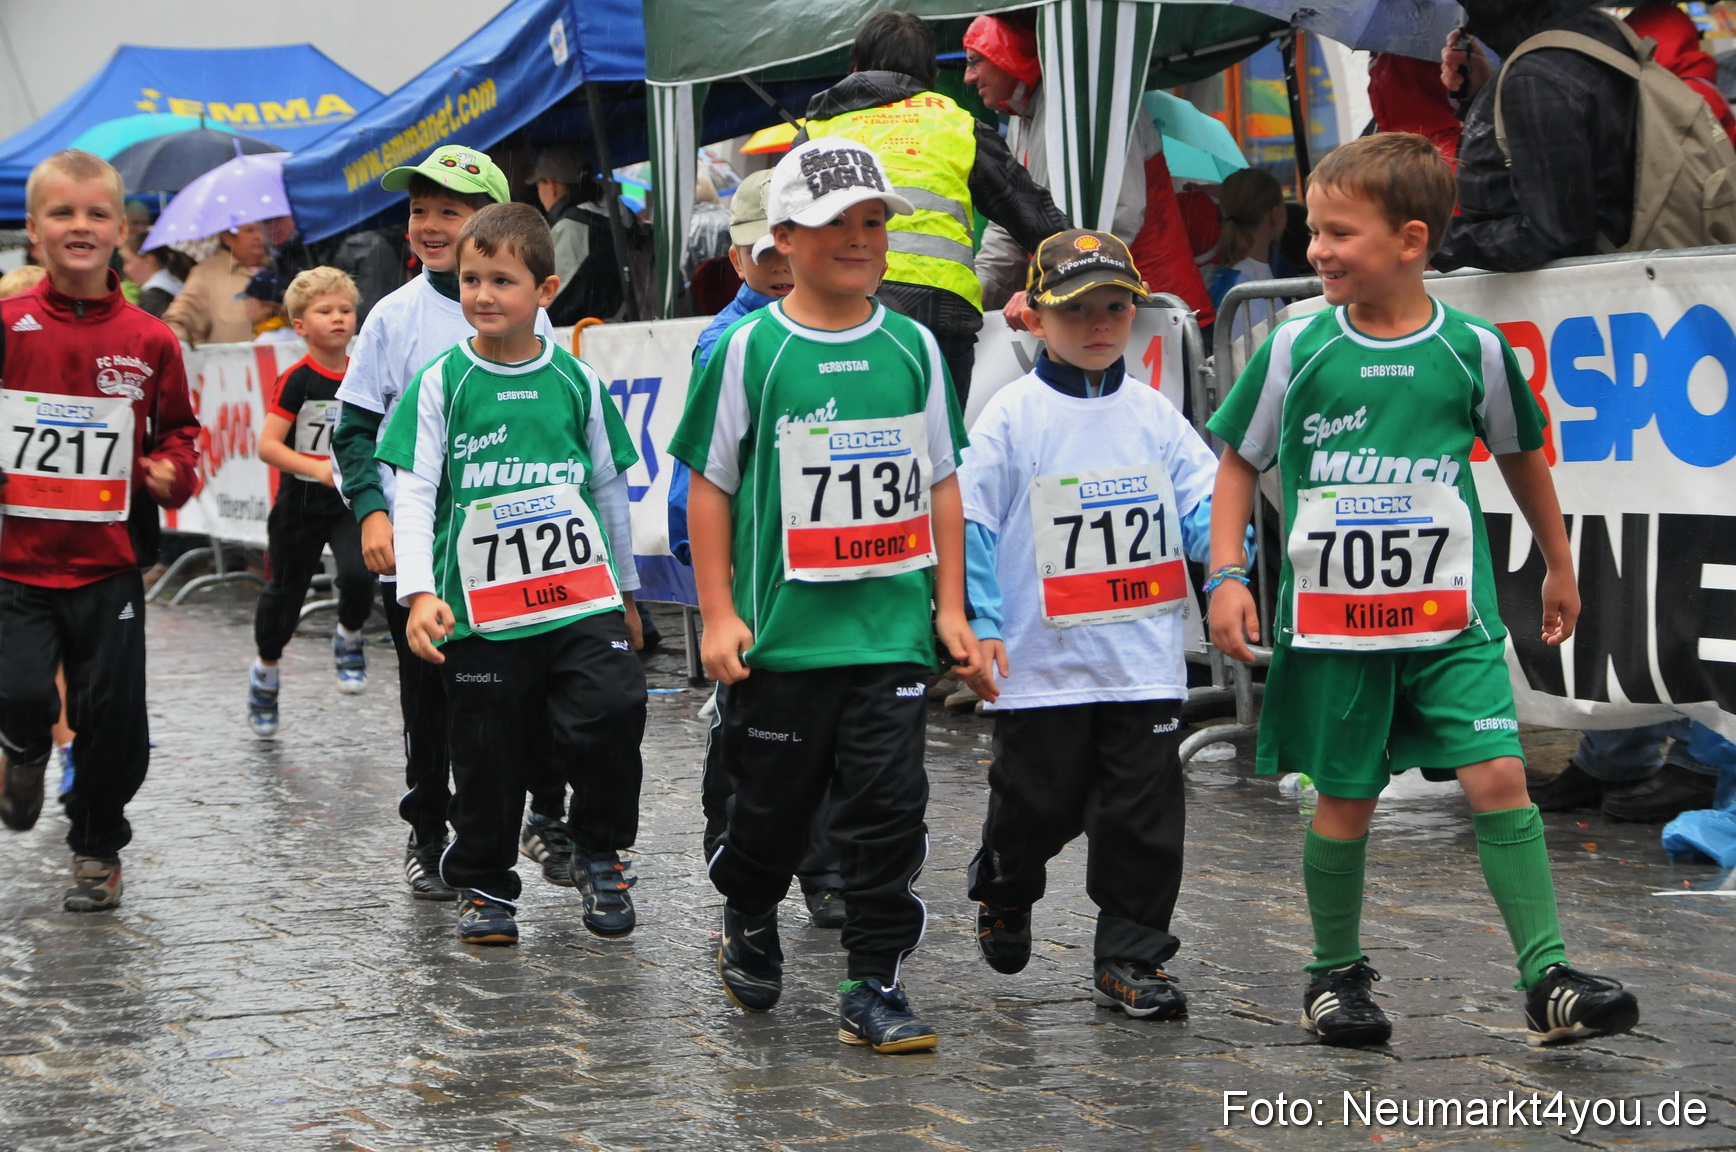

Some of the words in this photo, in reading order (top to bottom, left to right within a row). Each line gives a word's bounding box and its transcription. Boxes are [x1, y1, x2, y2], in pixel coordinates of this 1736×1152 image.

[167, 94, 357, 123] EMMA
[342, 78, 498, 192] www.emmanet.com
[1057, 256, 1098, 275] V-Power
[1100, 256, 1126, 268] Diesel
[818, 360, 869, 374] DERBYSTAR
[1360, 365, 1415, 378] DERBYSTAR
[497, 390, 538, 401] DERBYSTAR
[37, 402, 94, 419] BOCK
[1303, 405, 1367, 448] Sport
[12, 425, 119, 475] 7217
[453, 424, 508, 460] Sport
[830, 429, 901, 450] BOCK
[461, 457, 585, 489] Münch
[1309, 448, 1460, 487] Münch
[802, 457, 921, 522] 7134
[1079, 476, 1148, 499] BOCK
[493, 495, 556, 520] BOCK
[1335, 496, 1412, 515] BOCK
[790, 515, 797, 525] 2
[834, 535, 906, 560] Lorenz
[1053, 503, 1167, 570] 7121
[472, 517, 592, 582] 7126
[1307, 527, 1450, 590] 7057
[1045, 564, 1052, 574] 2
[469, 578, 476, 588] 2
[1107, 578, 1149, 602] Tim
[1302, 578, 1307, 589] 2
[1454, 576, 1463, 586] M
[523, 583, 568, 608] Luis
[1345, 603, 1414, 629] Kilian
[455, 672, 491, 683] Schrödl
[493, 673, 503, 683] L.
[896, 687, 919, 696] JAKO
[747, 727, 789, 741] Stepper
[792, 731, 802, 742] L.
[1152, 722, 1174, 733] JAKO
